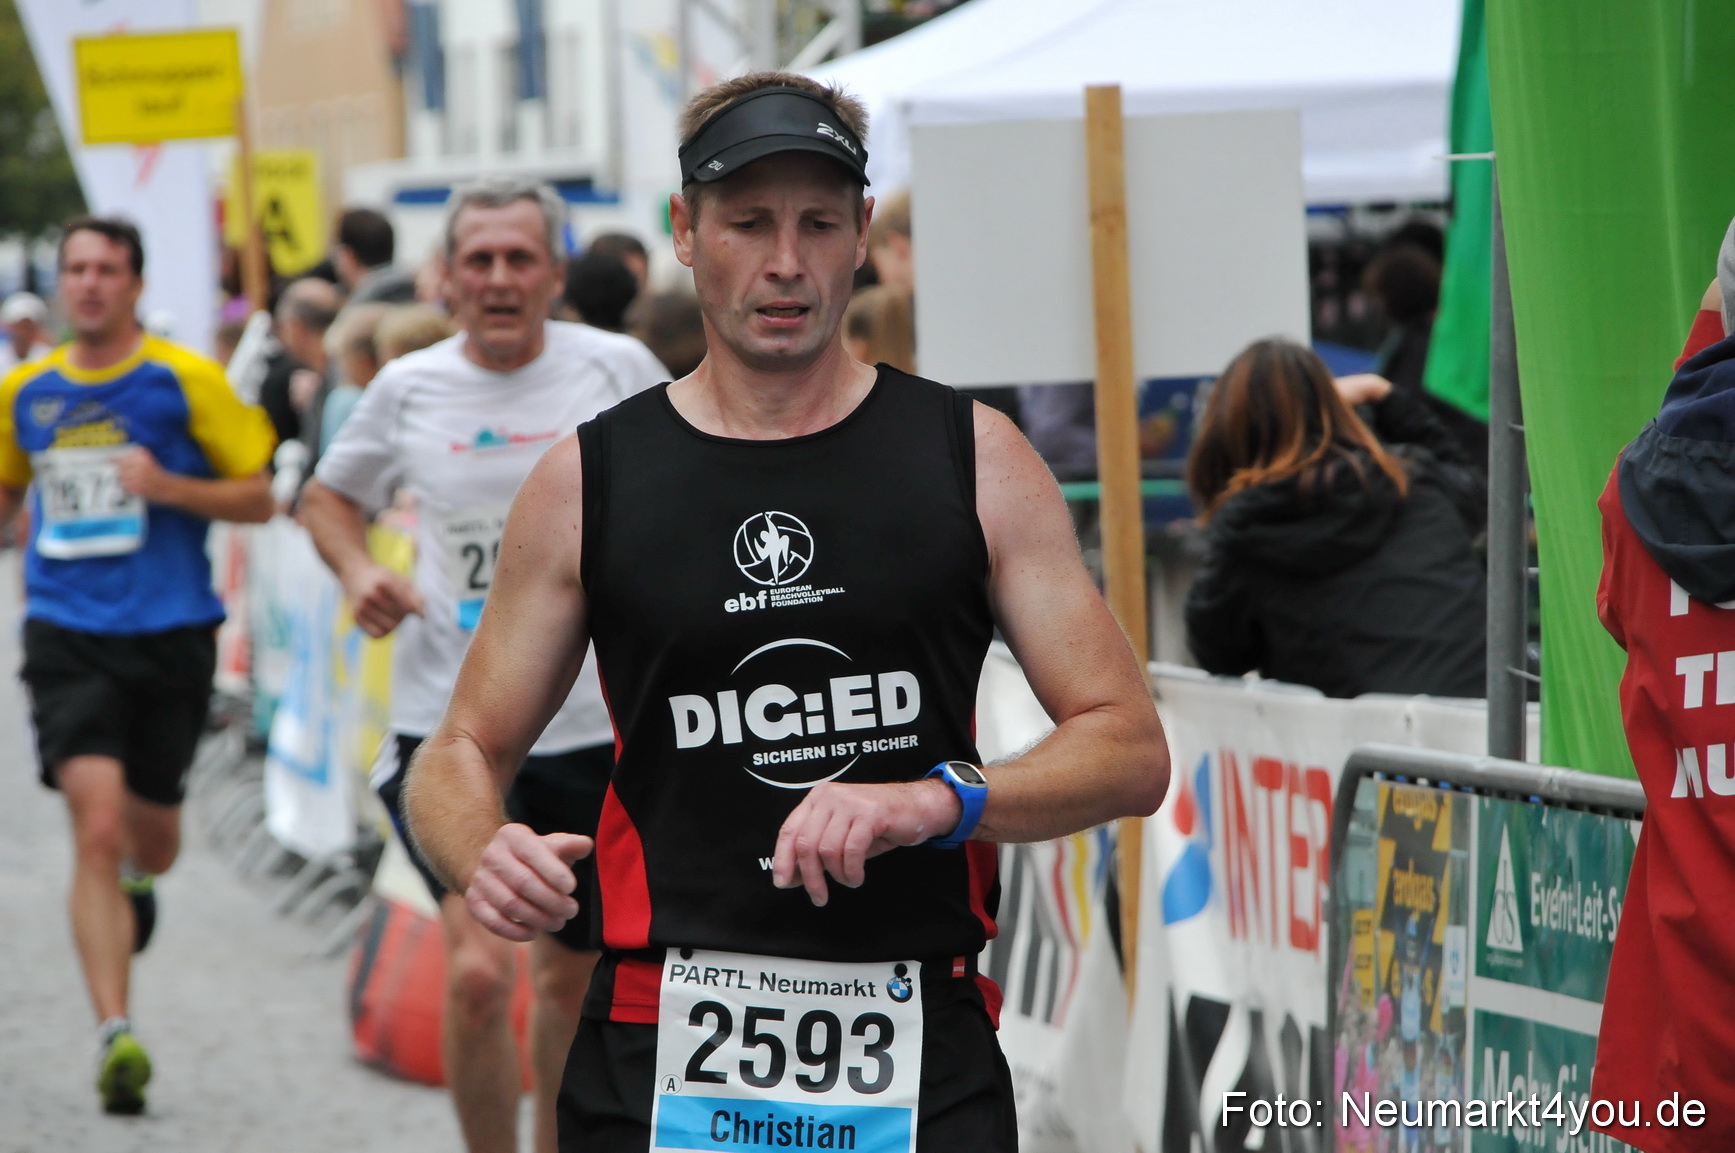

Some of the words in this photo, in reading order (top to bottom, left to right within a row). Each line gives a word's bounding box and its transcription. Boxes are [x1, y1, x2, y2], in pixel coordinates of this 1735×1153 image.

[769, 584, 812, 595] EUROPEAN
[770, 587, 846, 602] BEACHVOLLEYBALL
[724, 590, 768, 613] ebf
[771, 596, 823, 608] FOUNDATION
[752, 745, 826, 766] SICHERN
[831, 741, 857, 757] IST
[861, 734, 919, 754] SICHER
[669, 964, 752, 990] PARTL
[758, 972, 877, 998] Neumarkt
[684, 1000, 896, 1095] 2593
[665, 1077, 677, 1092] A
[710, 1109, 857, 1151] Christian
